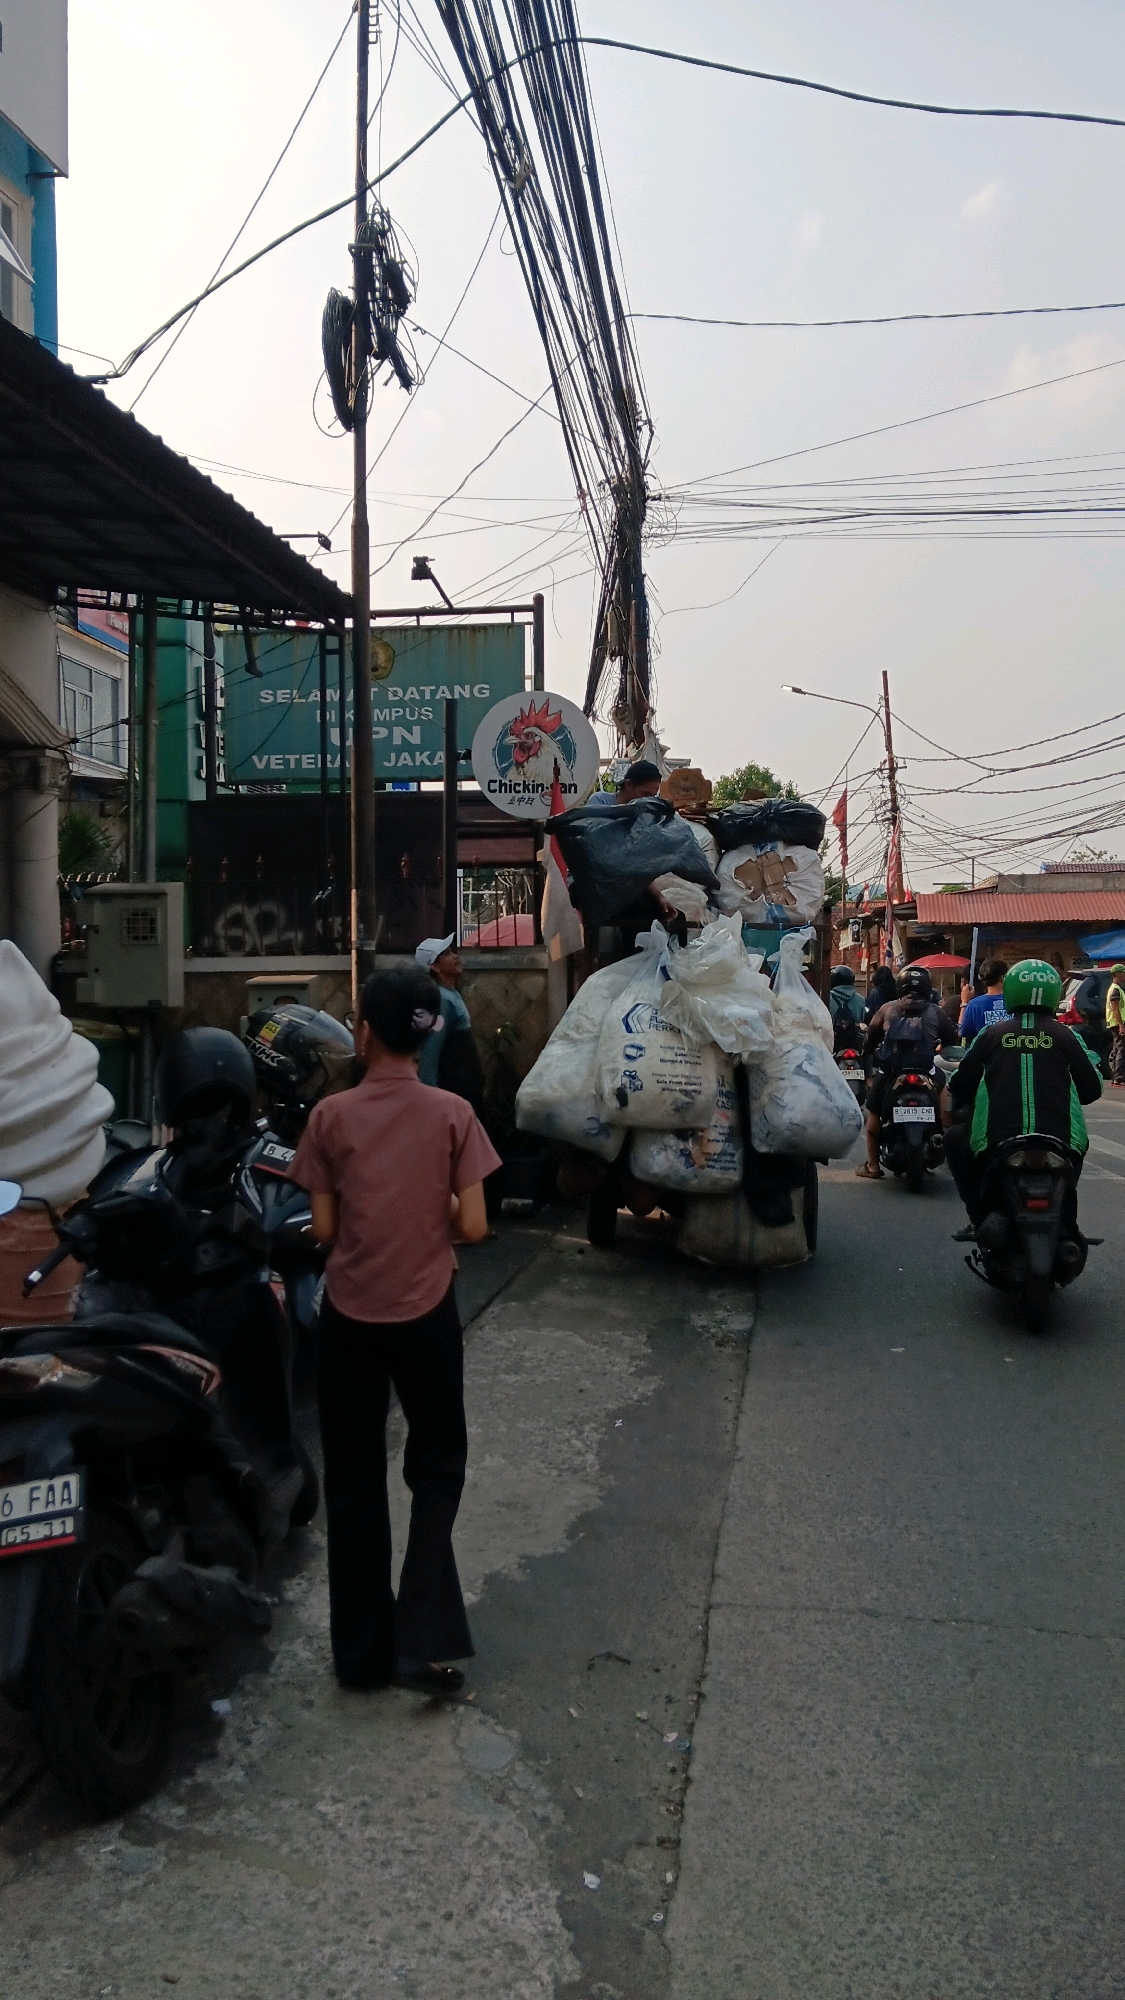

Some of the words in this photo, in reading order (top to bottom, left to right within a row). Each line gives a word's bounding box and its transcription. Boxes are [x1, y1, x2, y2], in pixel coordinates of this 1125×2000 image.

[388, 684, 490, 701] DATANG
[345, 706, 433, 722] KMPUS
[330, 726, 421, 746] UPN
[252, 754, 351, 769] VETERA
[1018, 970, 1056, 984] Grab
[1002, 1031, 1053, 1049] Grab
[29, 1480, 72, 1513] FAA
